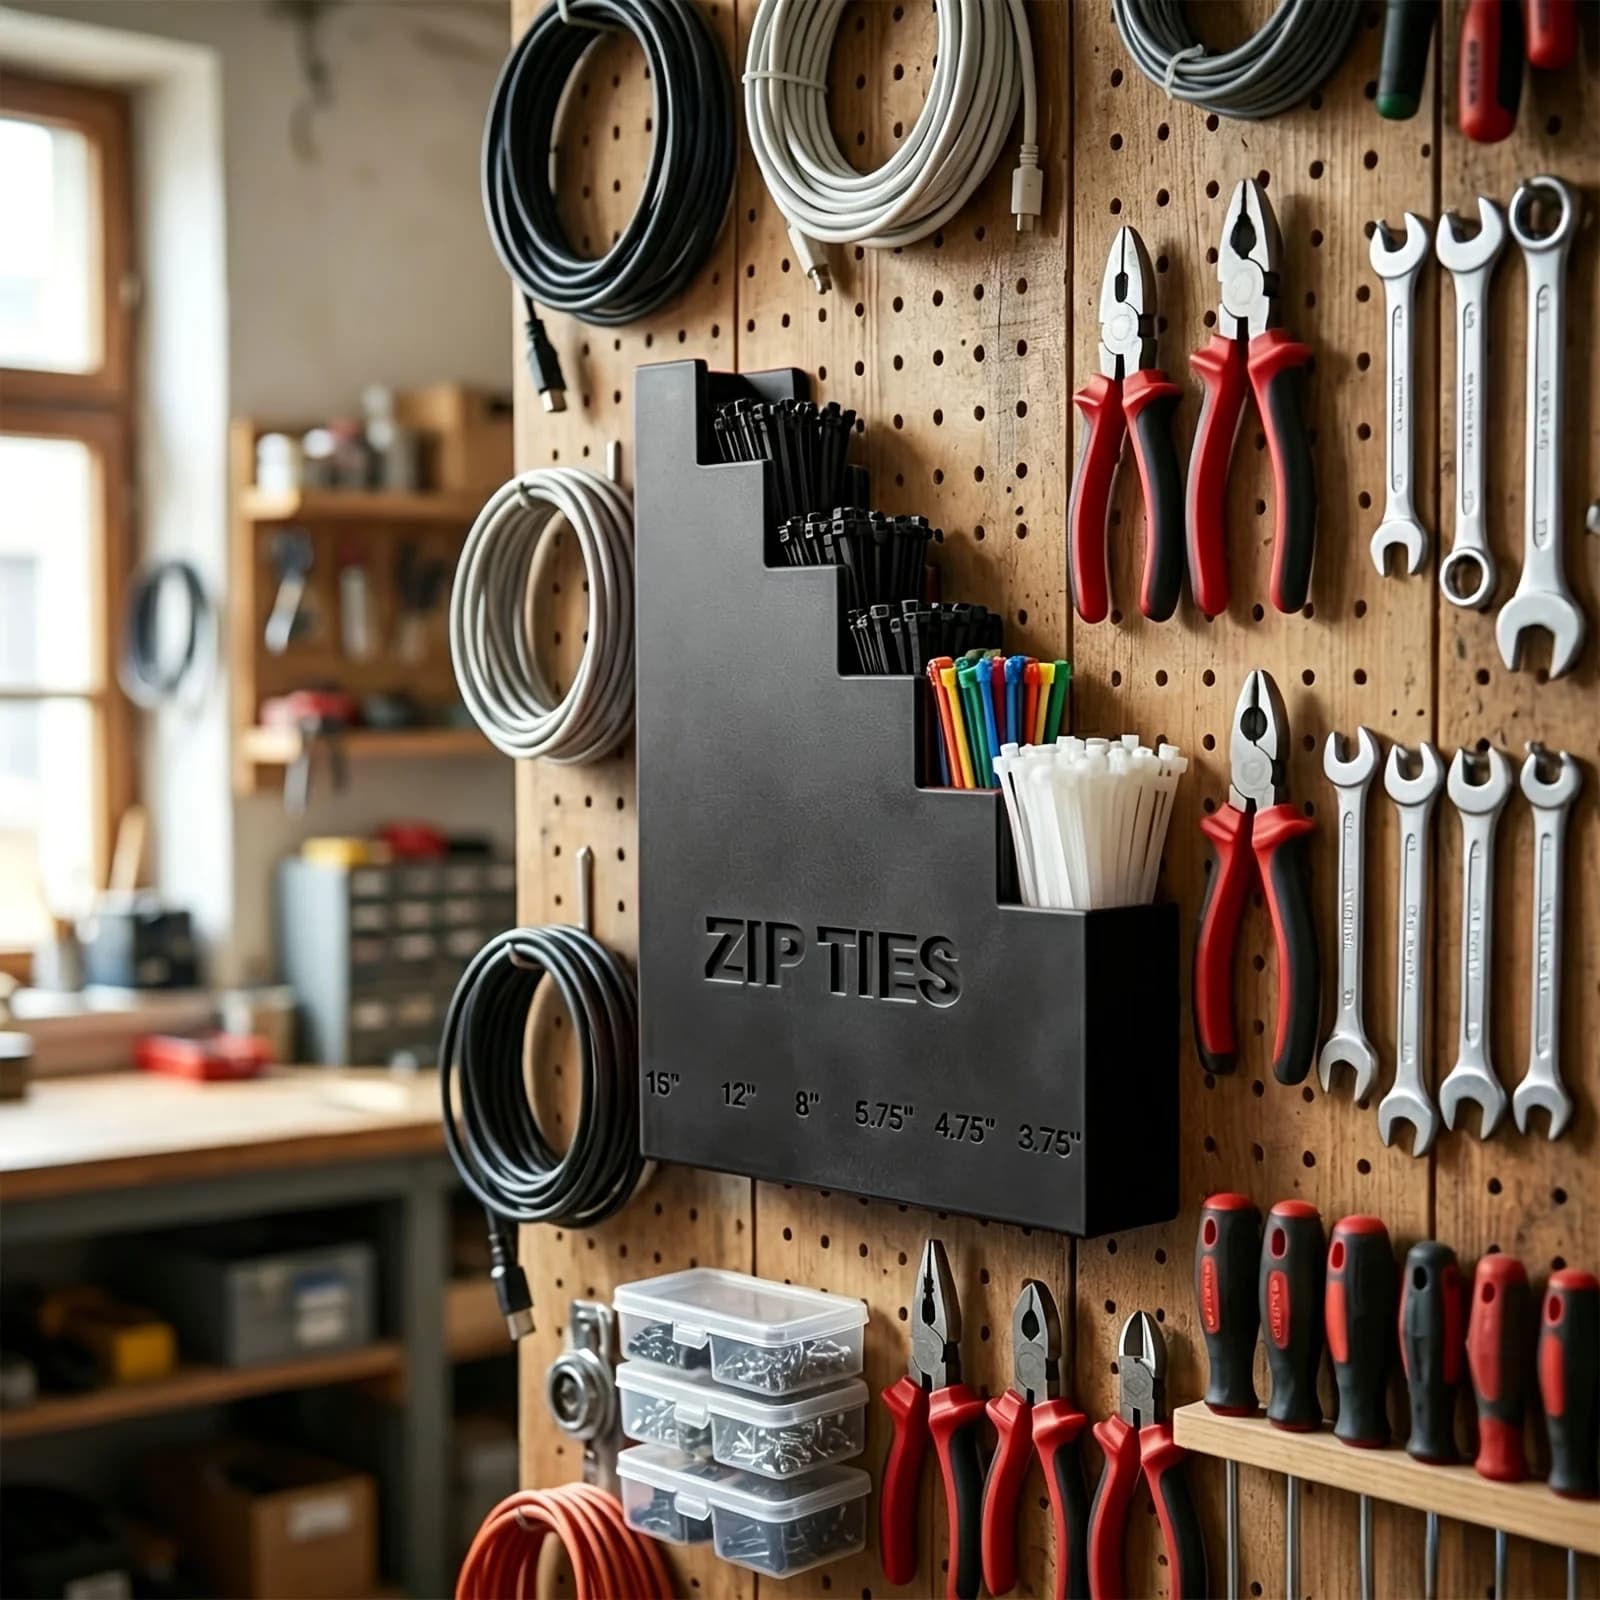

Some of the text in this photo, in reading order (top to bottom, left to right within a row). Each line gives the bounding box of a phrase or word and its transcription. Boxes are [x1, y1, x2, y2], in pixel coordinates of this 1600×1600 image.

[704, 916, 963, 1009] ZIP TIES
[721, 1082, 756, 1108] 12"
[795, 1091, 820, 1118] 8"
[855, 1100, 914, 1132] 5.75"
[935, 1111, 995, 1144] 4.75"
[1017, 1123, 1081, 1159] 3.75"
